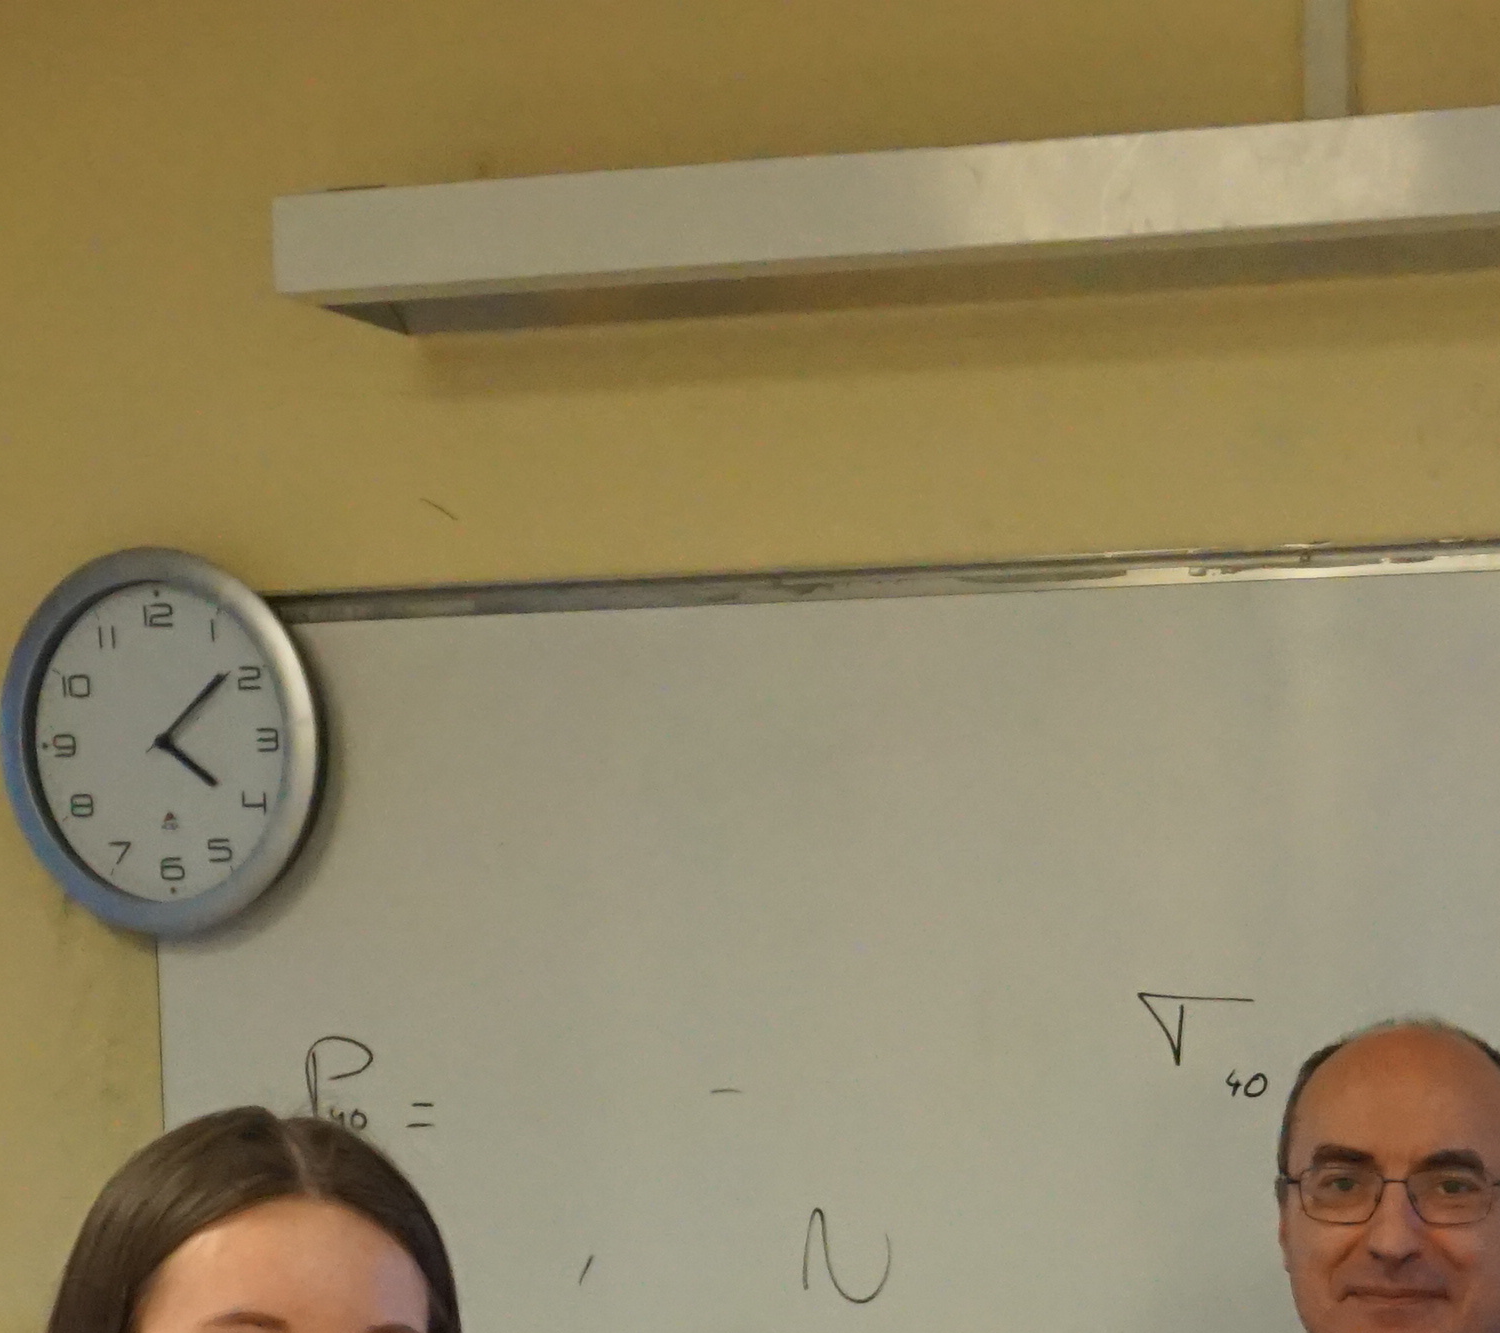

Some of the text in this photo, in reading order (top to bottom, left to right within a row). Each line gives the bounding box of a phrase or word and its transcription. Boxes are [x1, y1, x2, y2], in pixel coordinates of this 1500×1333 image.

[143, 602, 174, 628] 12
[98, 624, 116, 649] 11
[209, 618, 216, 642] 1
[61, 673, 91, 698] 10
[237, 665, 261, 691] 2
[52, 733, 77, 758] 9
[256, 727, 279, 752] 3
[70, 793, 94, 818] 8
[241, 790, 267, 814] 4
[109, 840, 132, 865] 7
[207, 838, 233, 863] 5
[160, 856, 185, 881] 6
